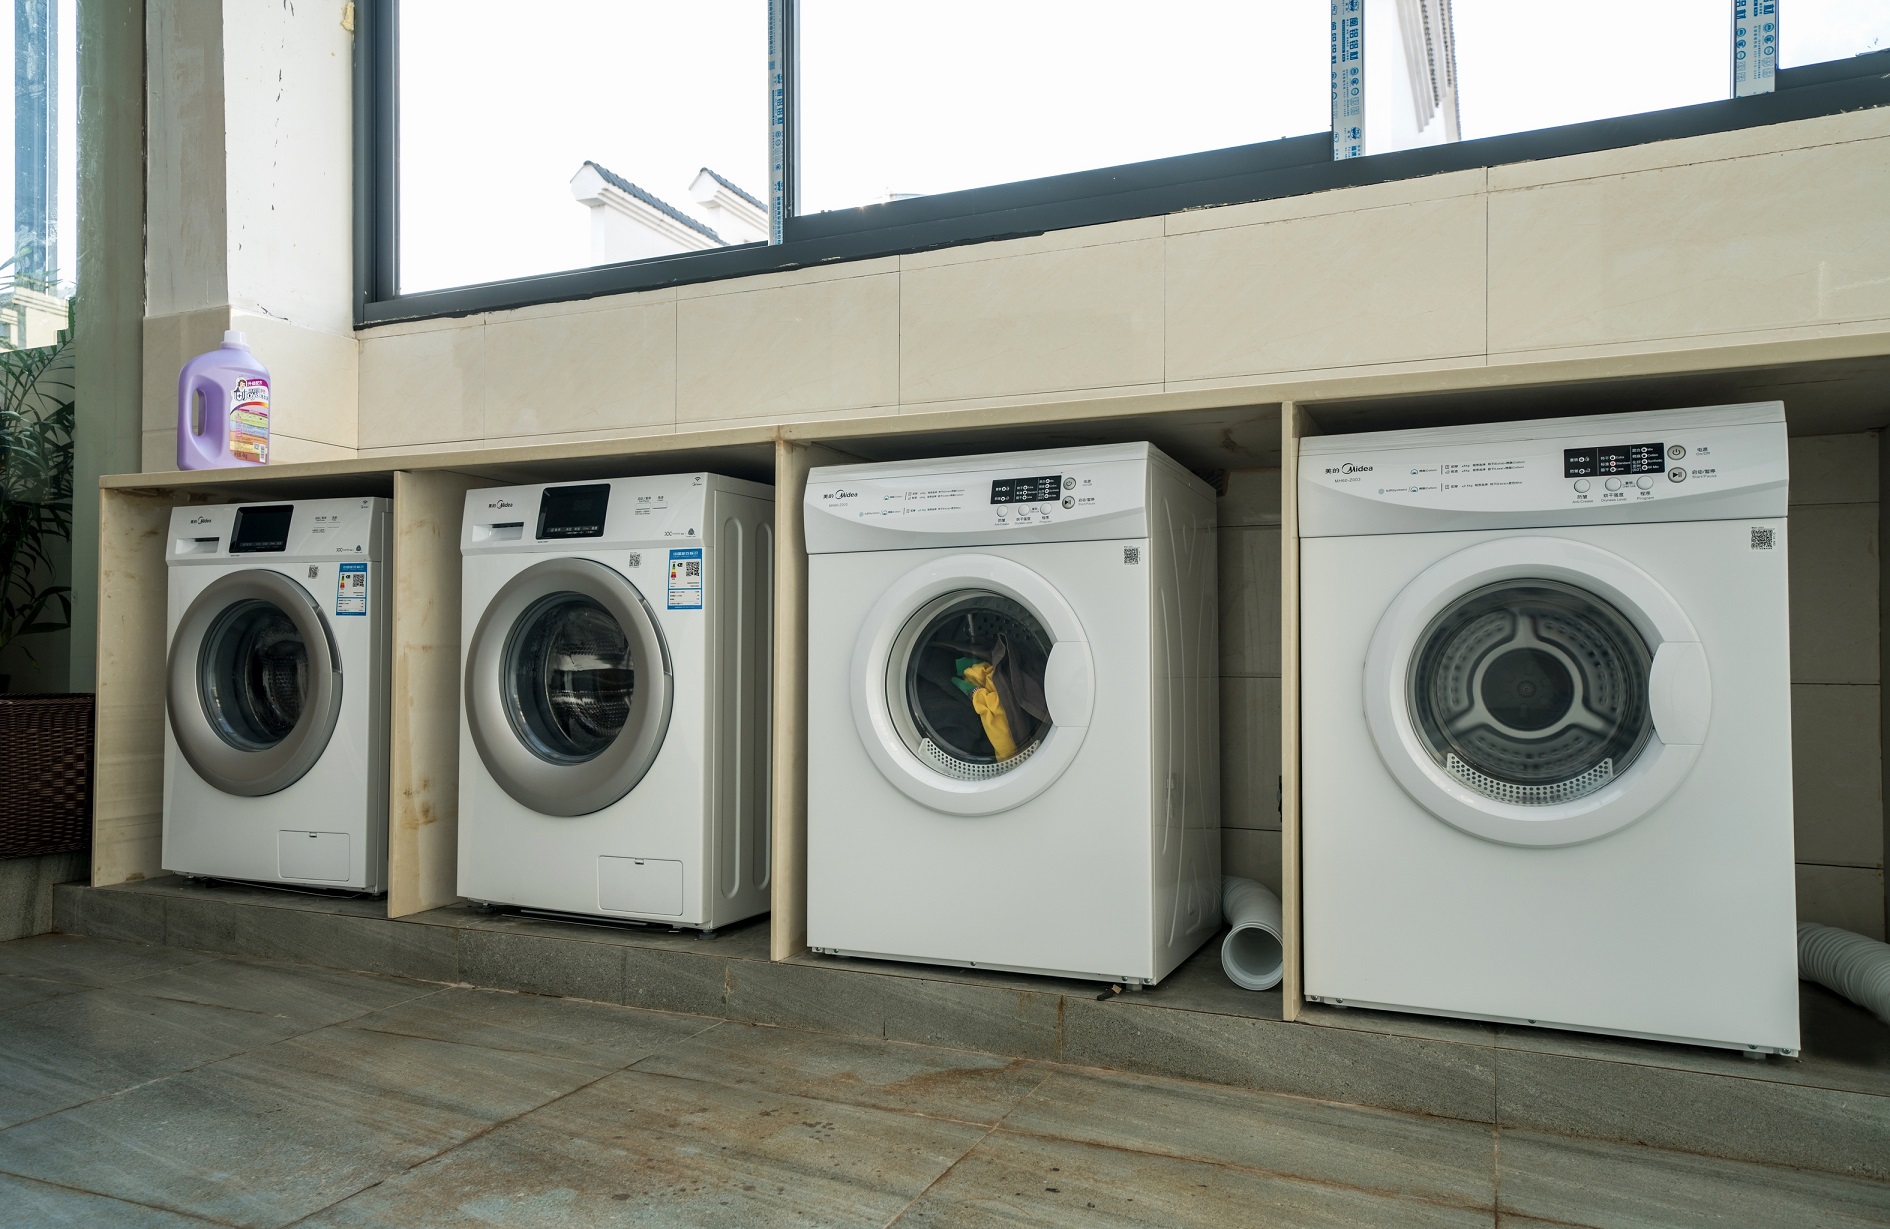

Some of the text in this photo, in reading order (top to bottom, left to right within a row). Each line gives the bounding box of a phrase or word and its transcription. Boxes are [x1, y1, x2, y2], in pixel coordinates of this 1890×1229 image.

[1342, 462, 1373, 474] Midea
[835, 489, 858, 499] Midea
[497, 500, 513, 509] Midea
[198, 516, 211, 524] Midea
